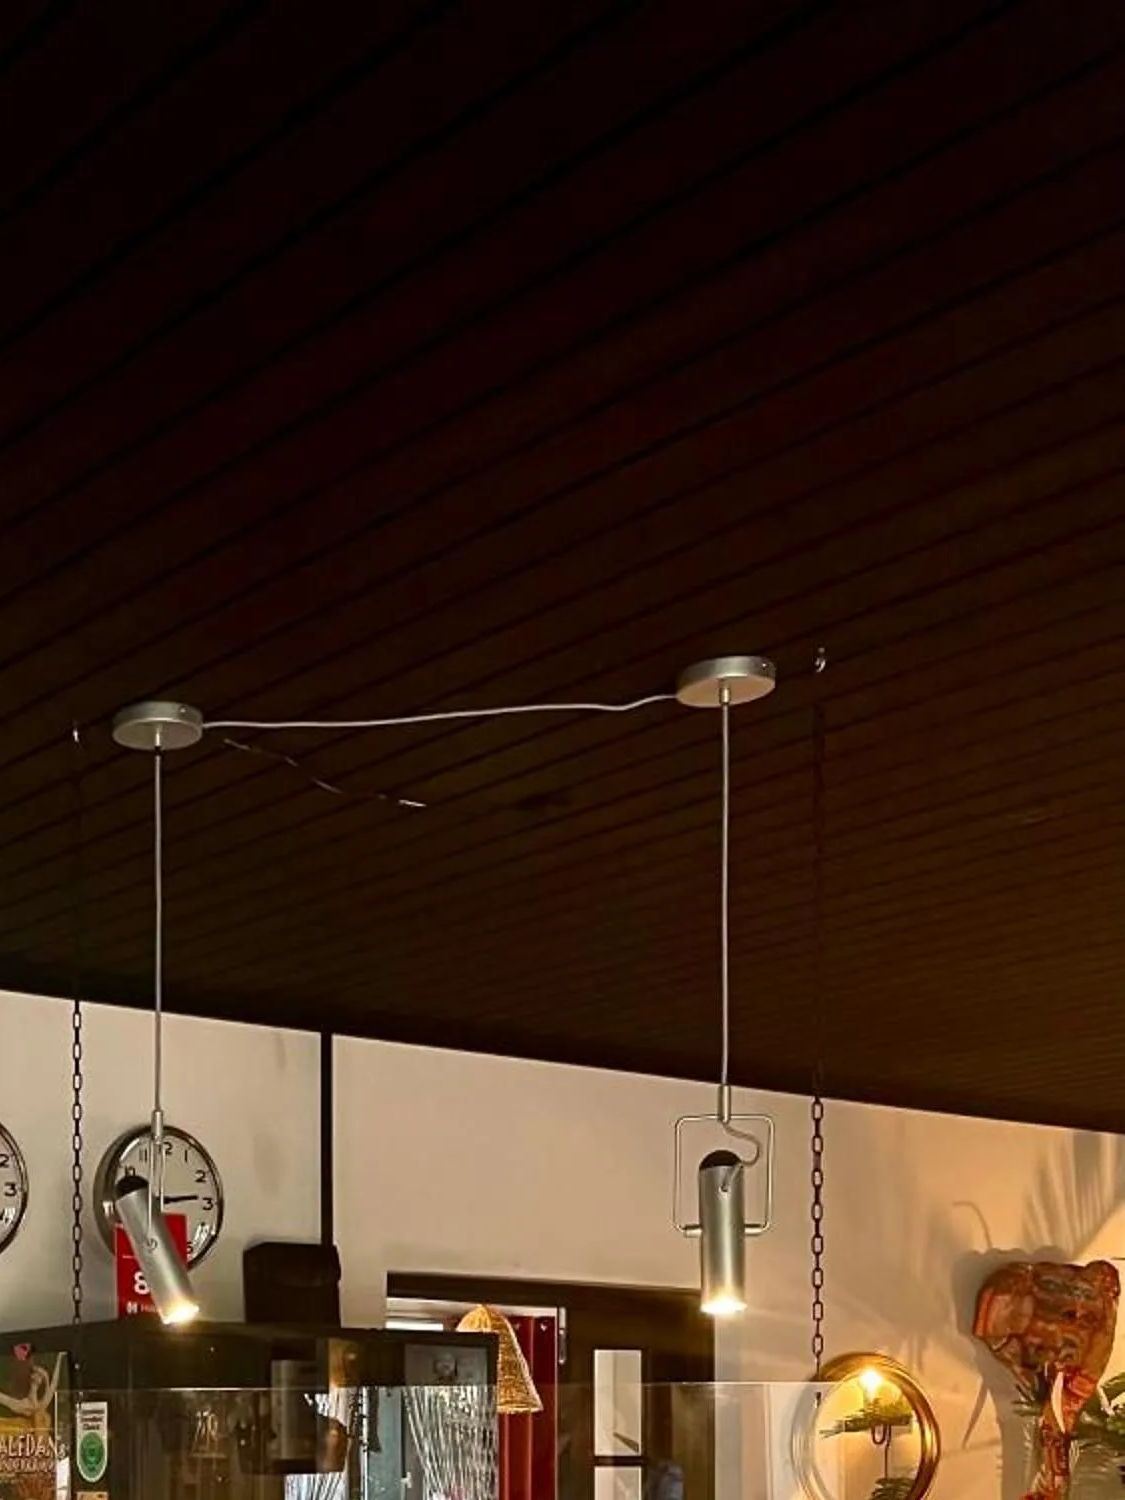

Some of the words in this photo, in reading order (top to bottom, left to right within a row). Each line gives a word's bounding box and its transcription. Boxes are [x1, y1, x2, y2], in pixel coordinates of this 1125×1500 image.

[138, 1148, 148, 1162] 11
[195, 1169, 207, 1183] 2
[4, 1182, 17, 1197] 3
[202, 1197, 214, 1211] 3
